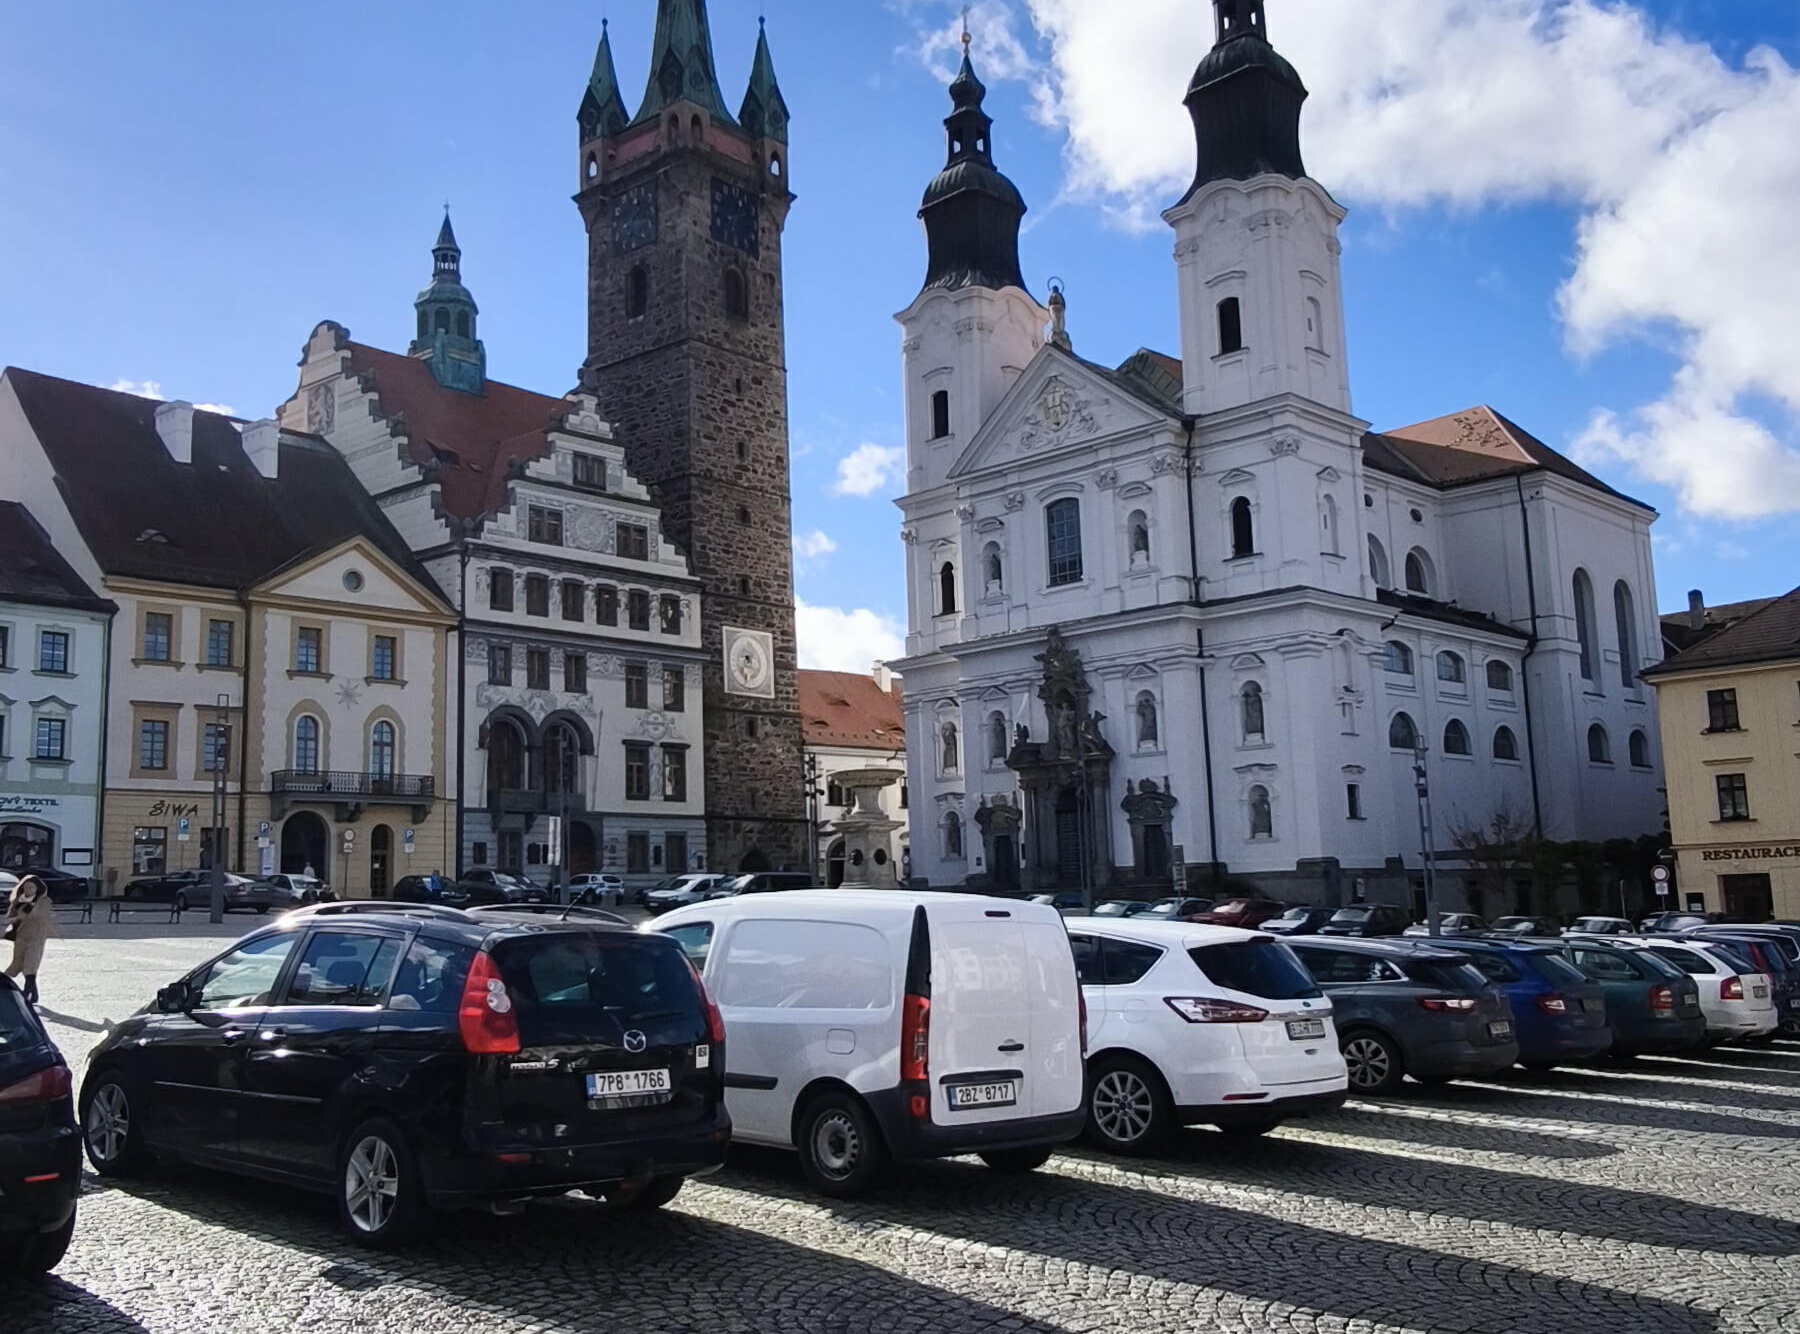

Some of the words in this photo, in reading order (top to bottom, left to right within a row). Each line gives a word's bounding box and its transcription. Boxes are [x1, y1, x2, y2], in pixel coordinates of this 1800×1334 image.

[180, 818, 188, 827] P
[261, 822, 269, 831] P
[406, 829, 414, 838] P
[599, 1073, 624, 1093] 7P8
[634, 1071, 665, 1090] 1766
[985, 1084, 1009, 1100] 8717
